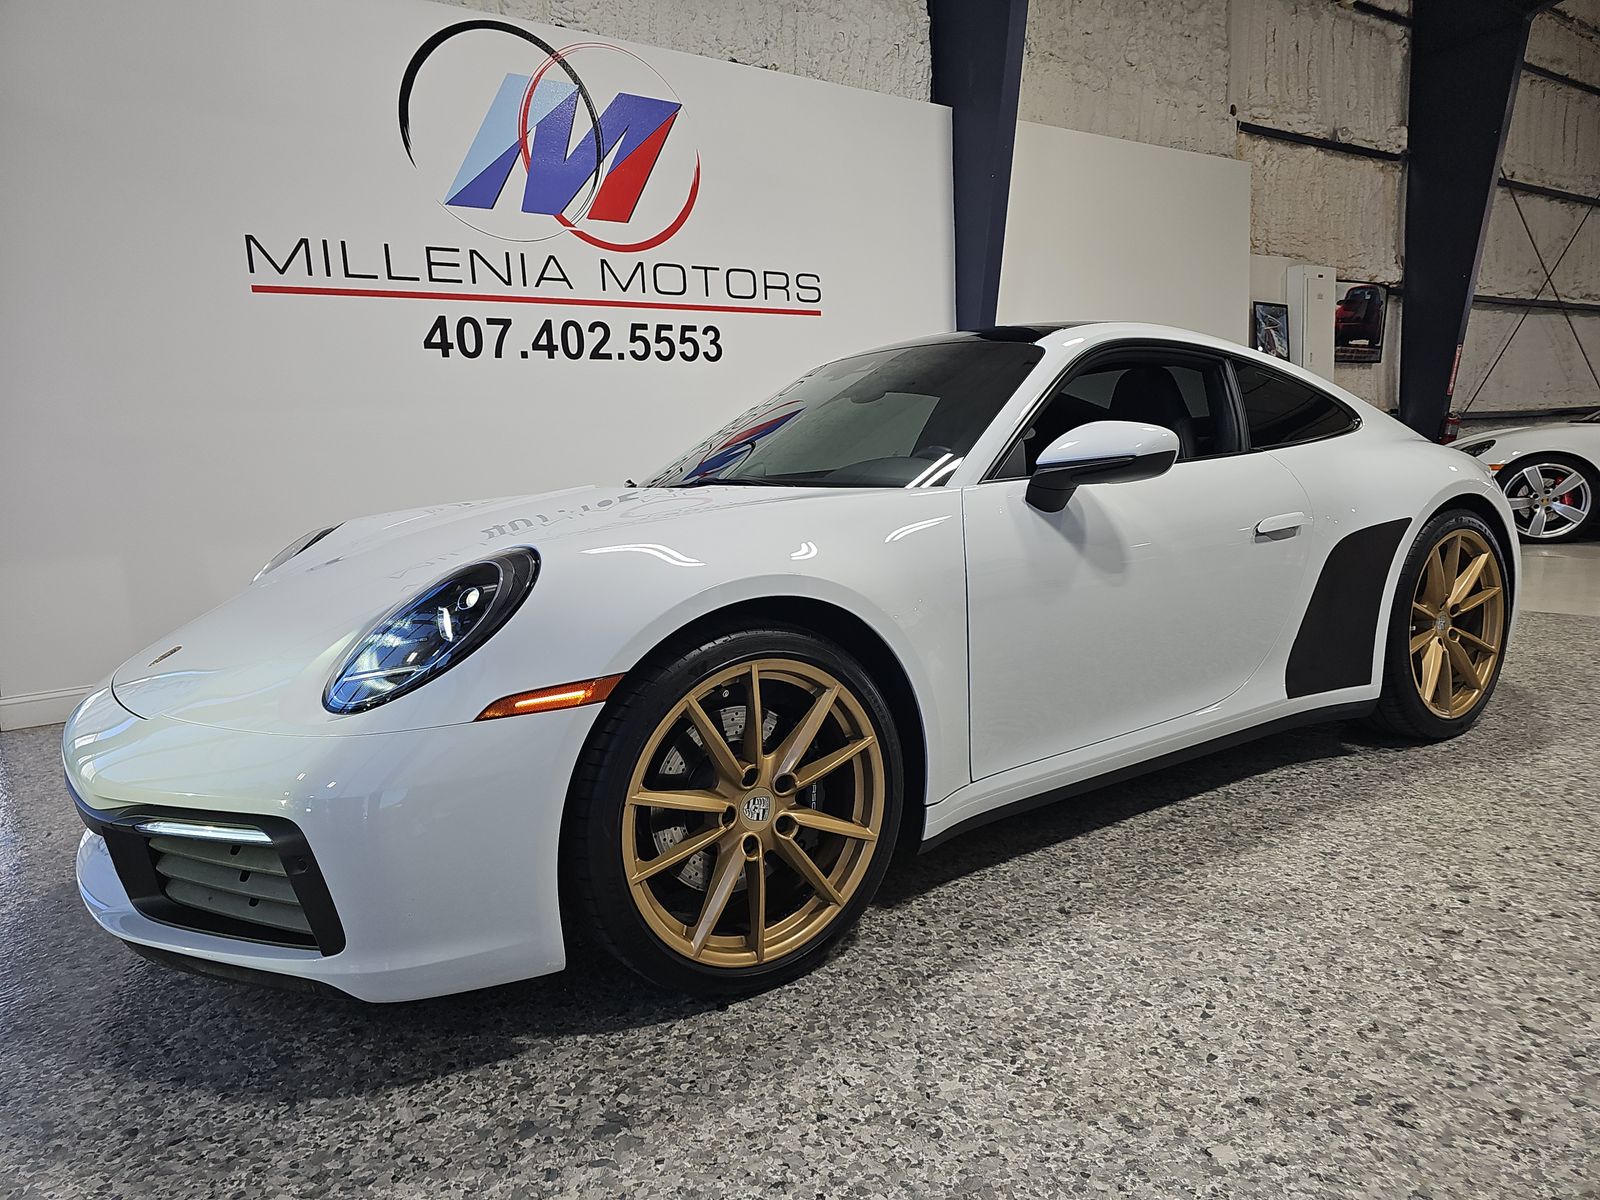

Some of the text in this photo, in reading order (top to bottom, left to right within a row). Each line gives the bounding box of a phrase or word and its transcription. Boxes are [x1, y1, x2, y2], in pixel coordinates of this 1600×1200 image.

[244, 234, 822, 304] MILLENIA MOTORS
[423, 315, 724, 363] 407.402.5553
